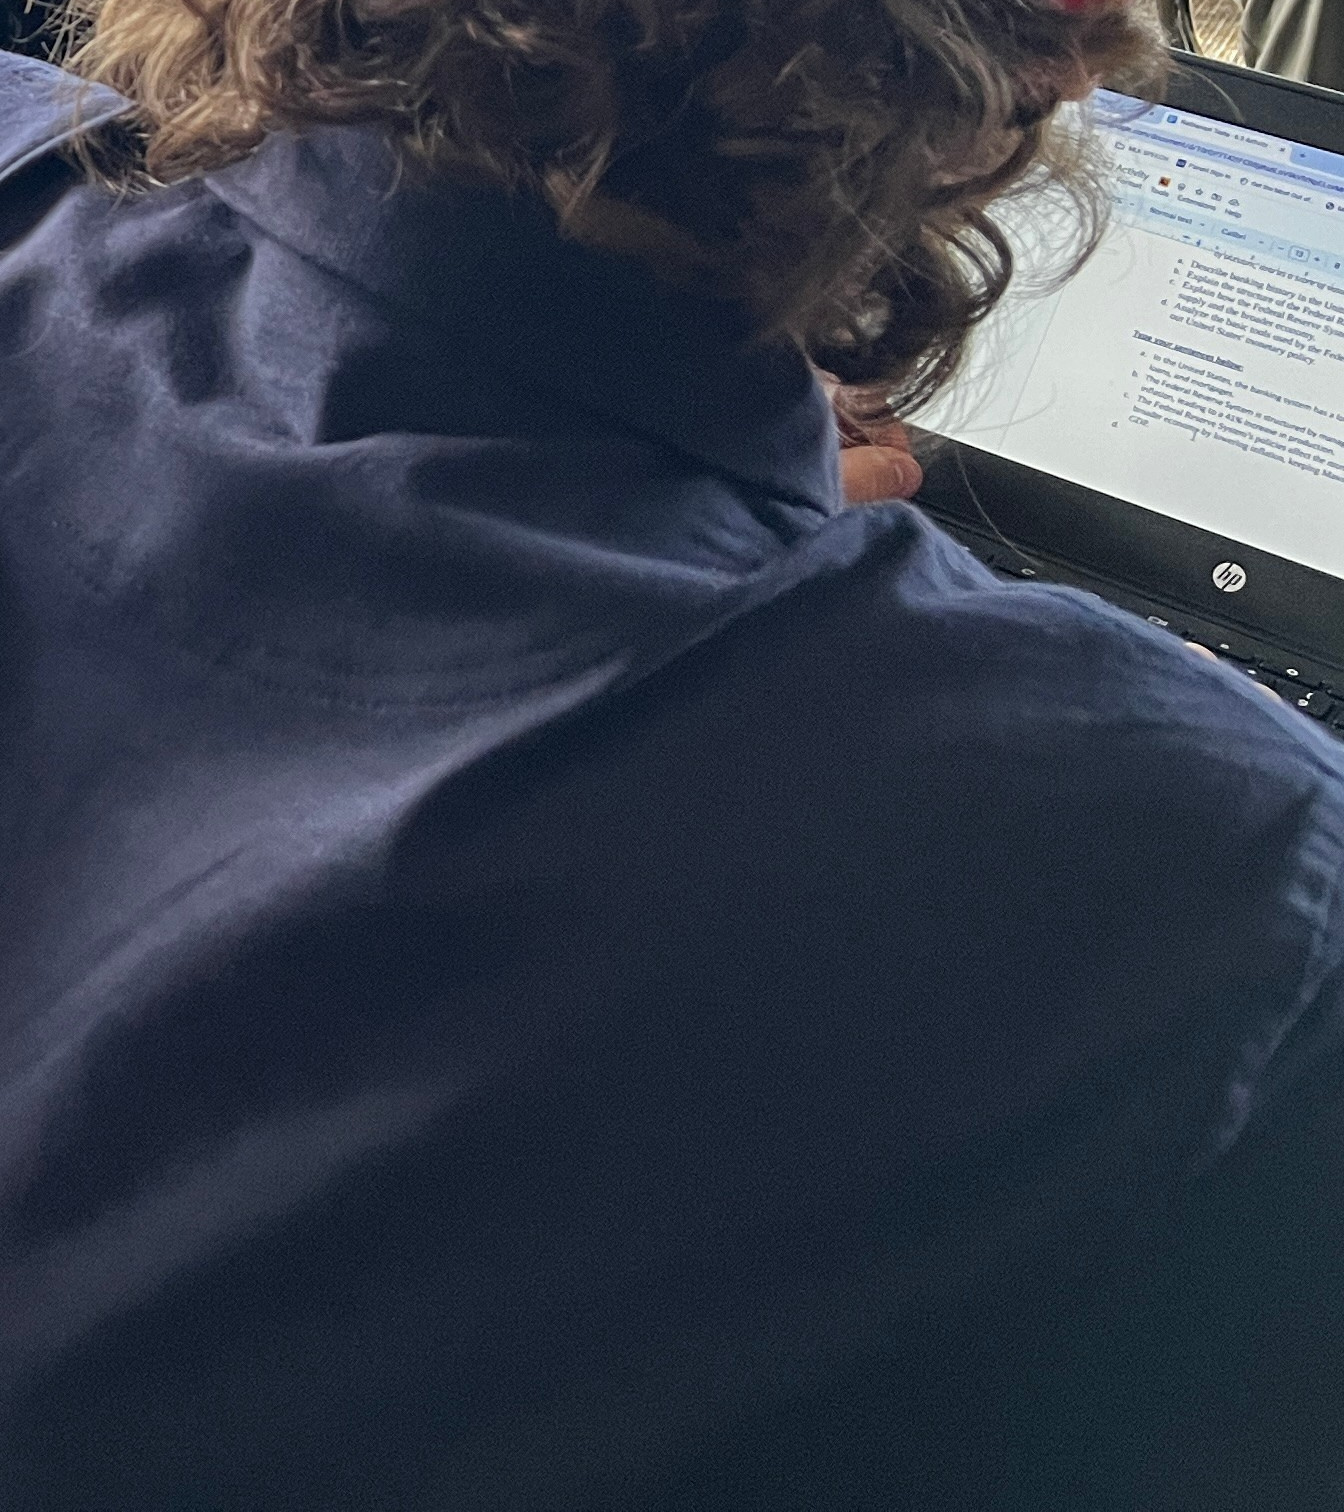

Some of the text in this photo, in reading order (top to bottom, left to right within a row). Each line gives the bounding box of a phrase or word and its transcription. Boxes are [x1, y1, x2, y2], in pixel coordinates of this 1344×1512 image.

[1114, 162, 1150, 181] Activity
[1149, 206, 1176, 219] Normal
[1220, 227, 1246, 241] Calibri
[1181, 280, 1216, 299] Explain
[1217, 291, 1235, 303] how
[1236, 297, 1251, 308] the
[1253, 301, 1285, 319] Federal
[1287, 313, 1321, 330] Reserve
[1186, 270, 1219, 288] Explain
[1220, 281, 1235, 291] the
[1236, 286, 1273, 304] structure
[1285, 300, 1301, 312] the
[1302, 305, 1335, 322] Federal
[1190, 259, 1228, 278] Describe
[1229, 271, 1264, 289] banking
[1265, 283, 1295, 299] history
[1307, 296, 1322, 306] the
[1173, 301, 1209, 321] Analyze
[1210, 313, 1224, 323] the
[1225, 317, 1248, 331] basic
[1249, 325, 1272, 338] tools
[1272, 331, 1294, 345] used
[1307, 343, 1322, 354] the
[1177, 290, 1316, 343] supply and the broader economy.
[1185, 316, 1215, 332] United
[1244, 337, 1285, 356] monetary
[1286, 349, 1316, 366] policy.
[1132, 329, 1153, 342] Type
[1153, 337, 1173, 349] your
[1173, 343, 1214, 362] sentences
[1144, 374, 1160, 384] The
[1160, 379, 1191, 395] Federal
[1191, 389, 1224, 405] Reserve
[1224, 400, 1254, 416] System
[1263, 414, 1306, 433] structured
[1148, 363, 1234, 398] loans, and mortgages.
[1162, 357, 1176, 366] the
[1177, 361, 1205, 376] United
[1234, 380, 1248, 390] the
[1249, 385, 1282, 402] banking
[1282, 397, 1311, 411] system
[1312, 405, 1327, 416] has
[1136, 394, 1153, 405] The
[1153, 400, 1183, 416] Federal
[1184, 410, 1217, 427] Reserve
[1254, 434, 1287, 452] policies
[1287, 445, 1312, 459] affect
[1312, 454, 1326, 464] the
[1140, 384, 1176, 402] inflation,
[1176, 396, 1206, 413] leading
[1243, 418, 1278, 436] increase
[1288, 434, 1336, 456] production.
[1213, 431, 1249, 451] lowering
[1249, 443, 1287, 463] inflation,
[1287, 457, 1321, 476] keeping
[1217, 562, 1244, 591] hp
